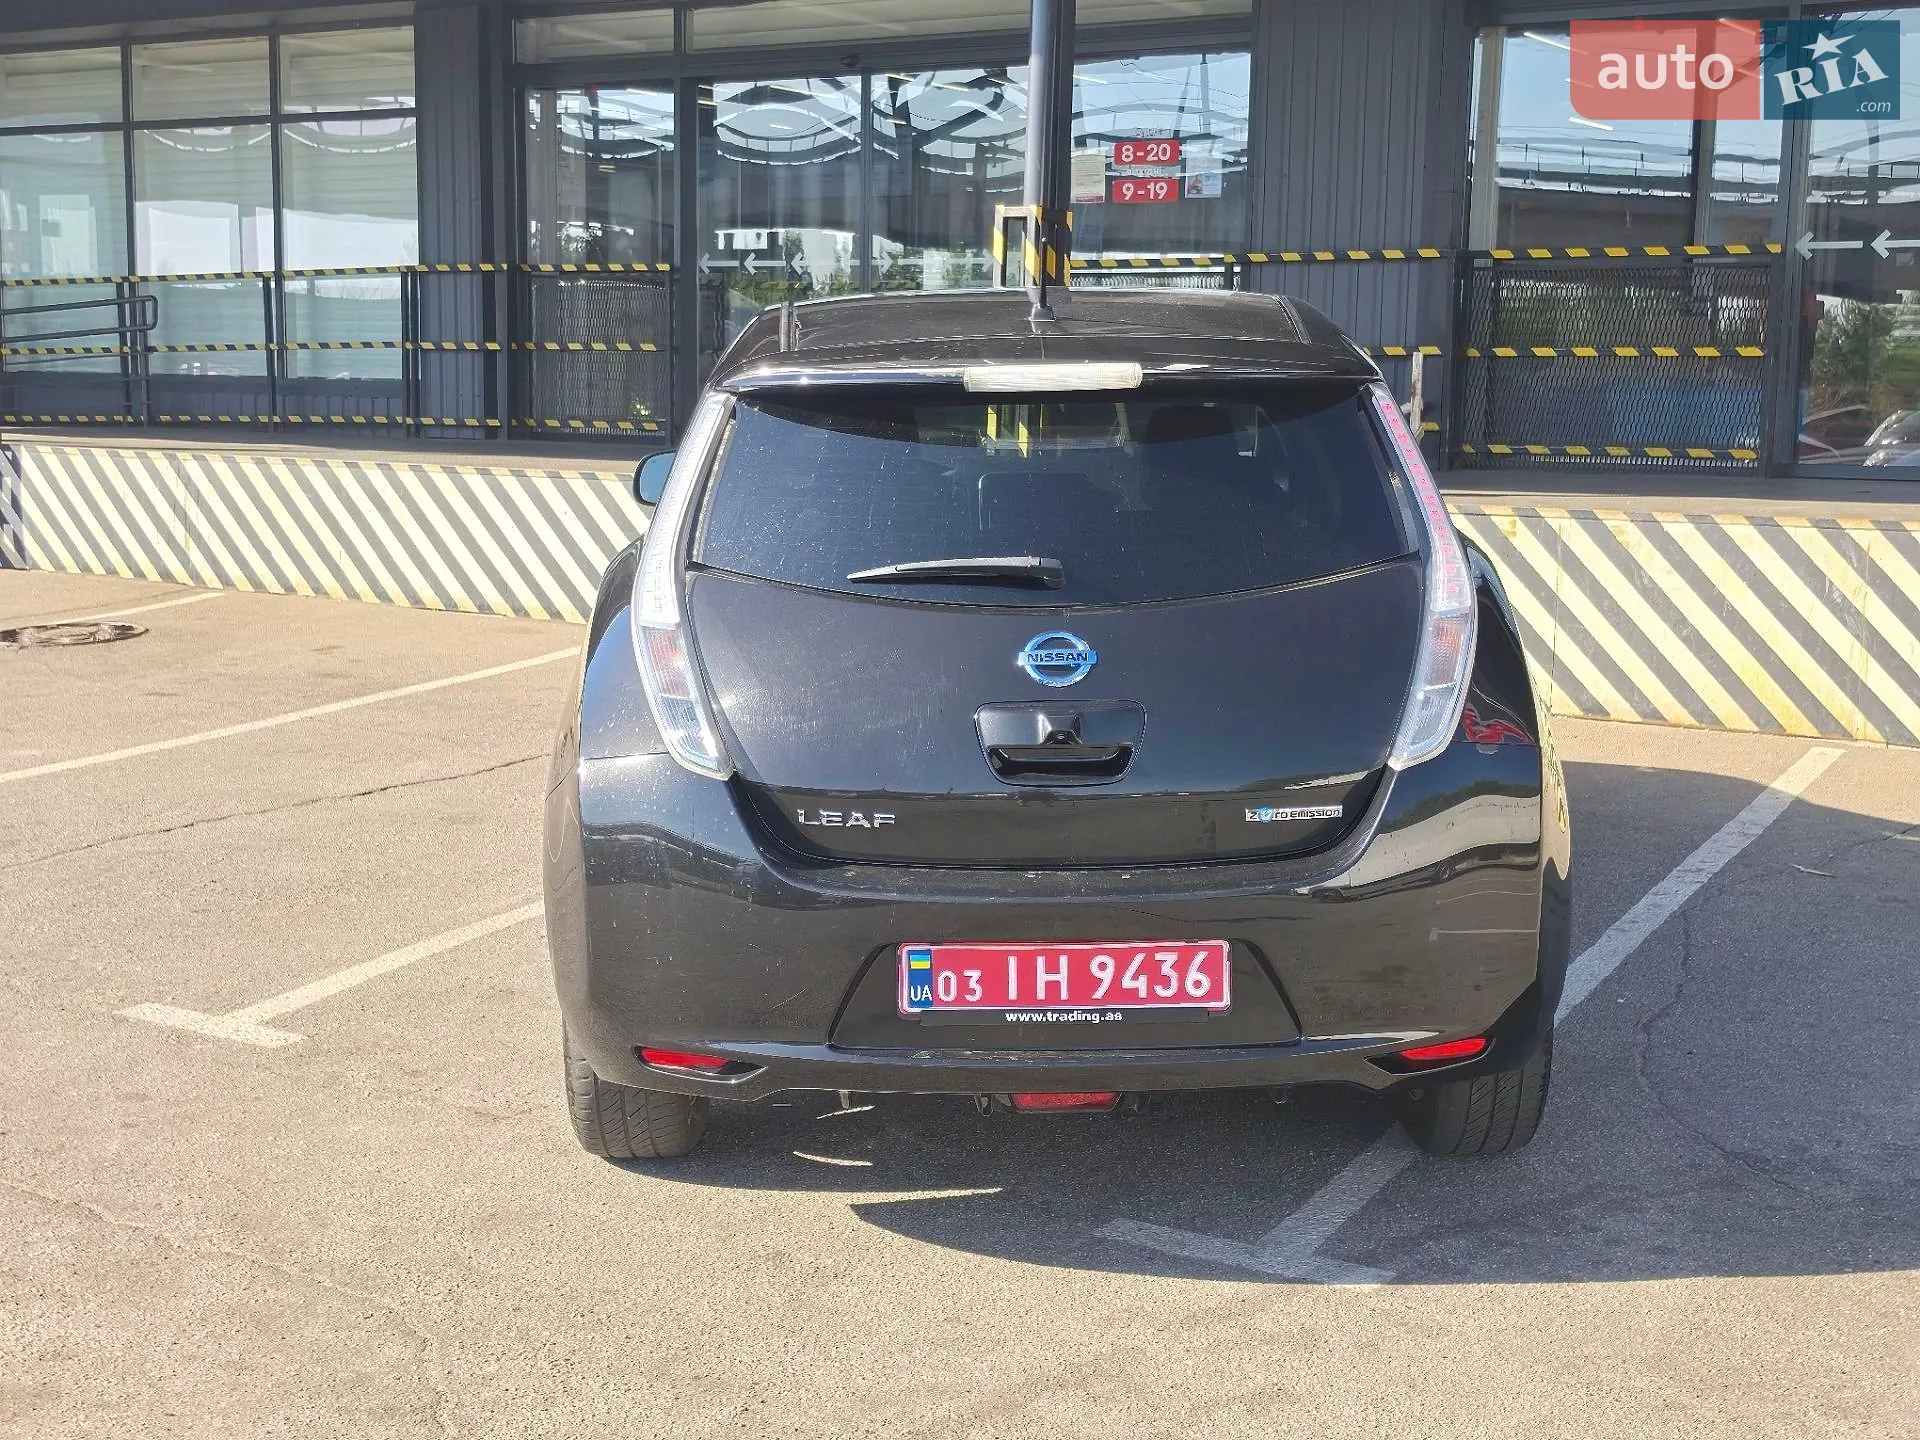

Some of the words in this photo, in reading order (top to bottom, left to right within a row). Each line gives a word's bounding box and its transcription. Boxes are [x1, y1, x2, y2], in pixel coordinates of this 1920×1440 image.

[1121, 143, 1171, 163] 8-20
[1122, 182, 1168, 201] 9-19
[1027, 652, 1088, 663] NISSAN
[797, 809, 896, 828] LEAF
[937, 970, 983, 1002] 03
[1007, 954, 1069, 1001] IH
[1089, 951, 1212, 1000] 9436
[910, 985, 933, 1002] UA
[1005, 1010, 1123, 1024] www.trading.as
